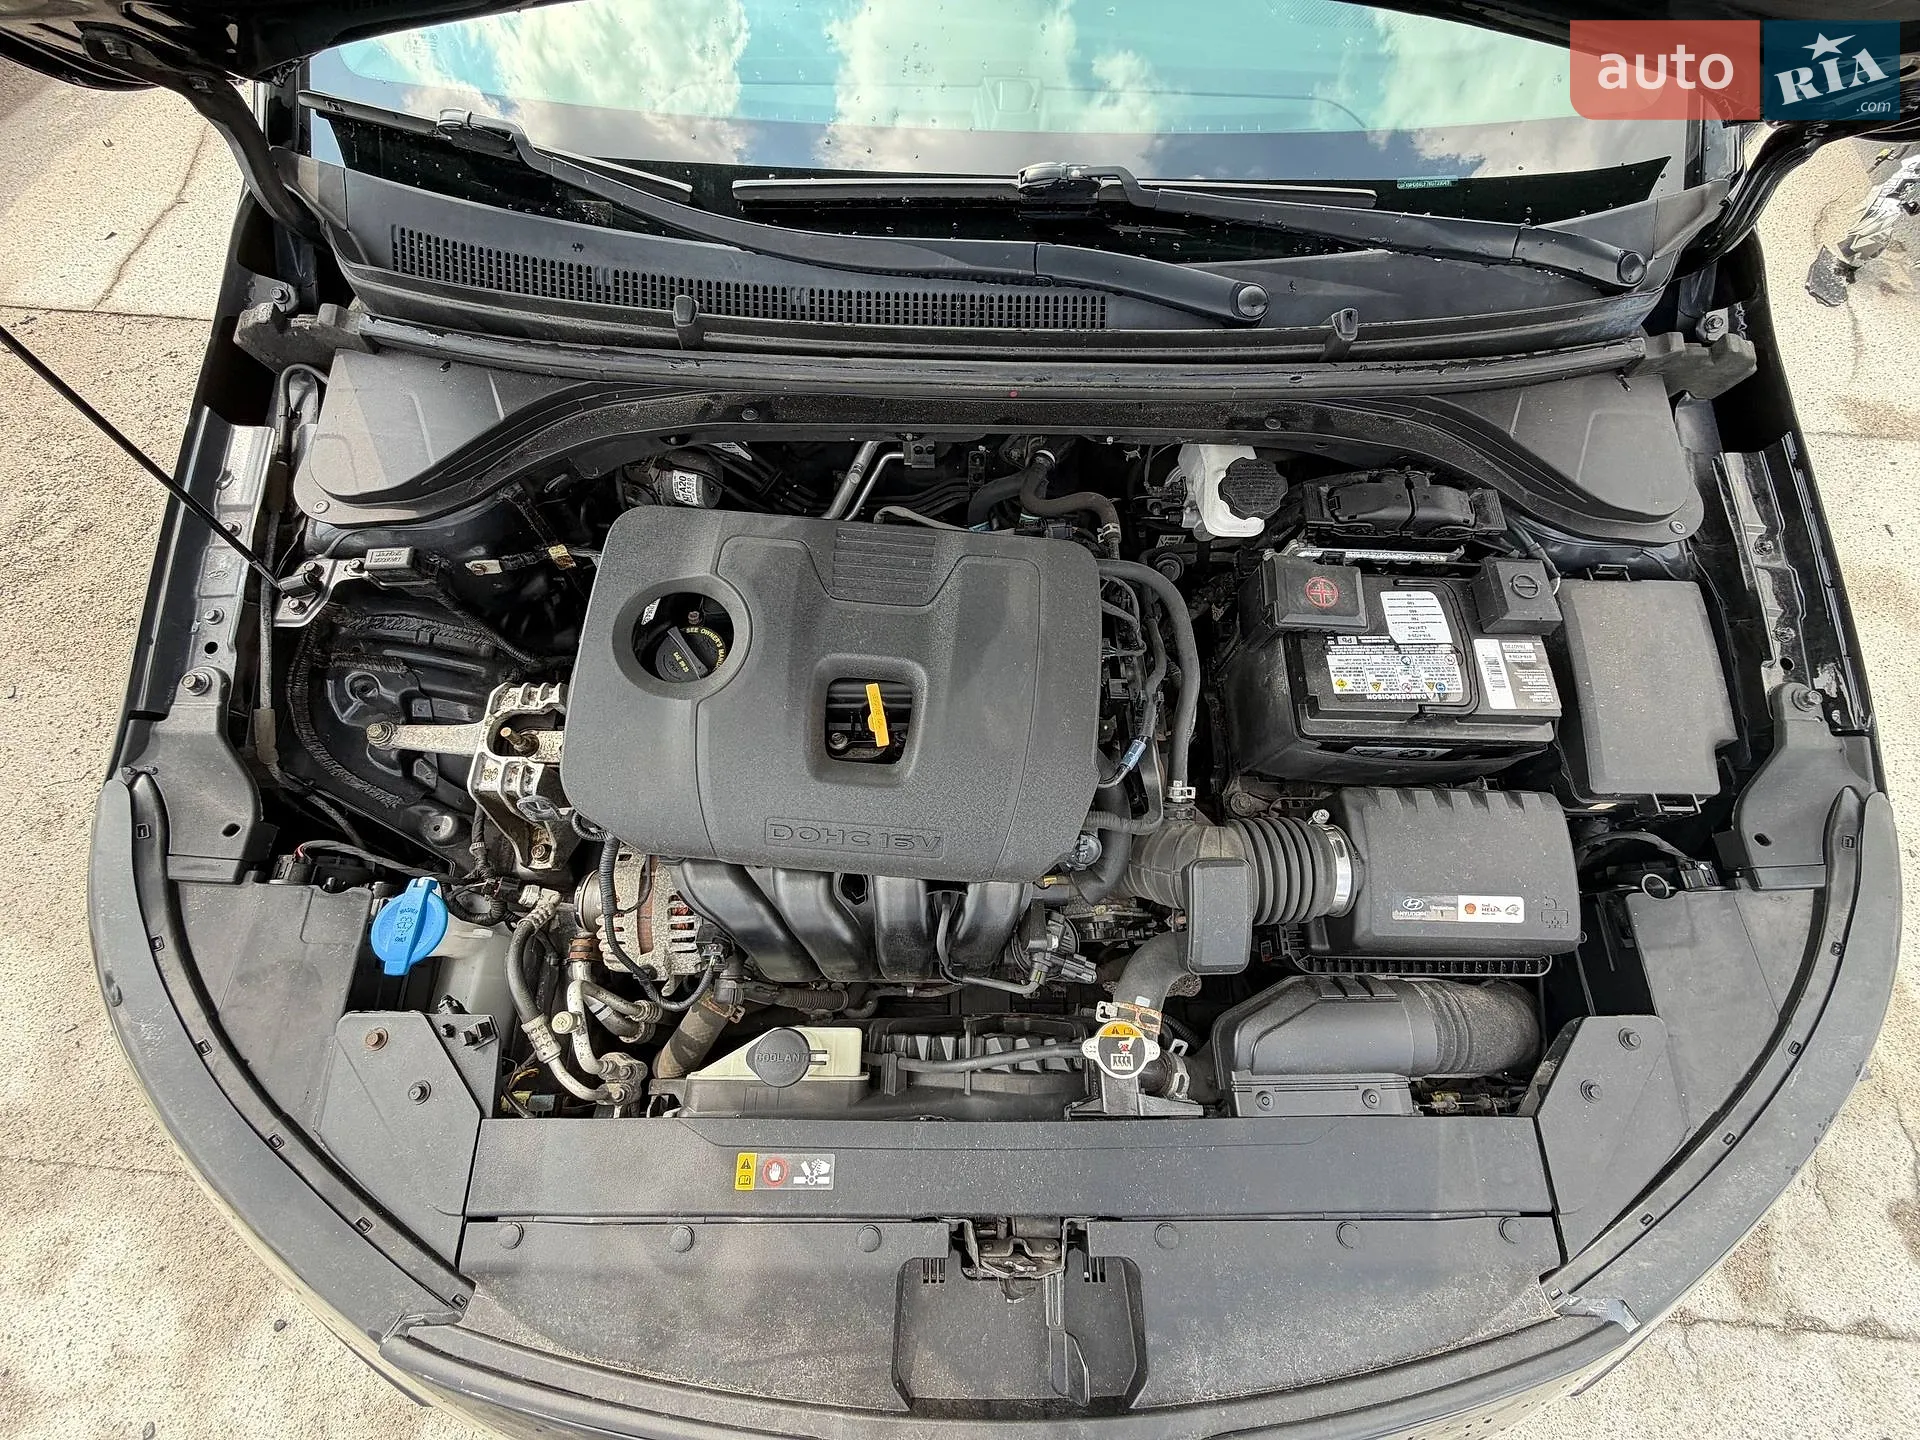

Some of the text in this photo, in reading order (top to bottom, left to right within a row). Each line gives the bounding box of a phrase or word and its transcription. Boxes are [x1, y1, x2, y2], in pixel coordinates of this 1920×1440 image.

[768, 823, 941, 852] DOHC 16V
[755, 1052, 808, 1063] COOLANT
